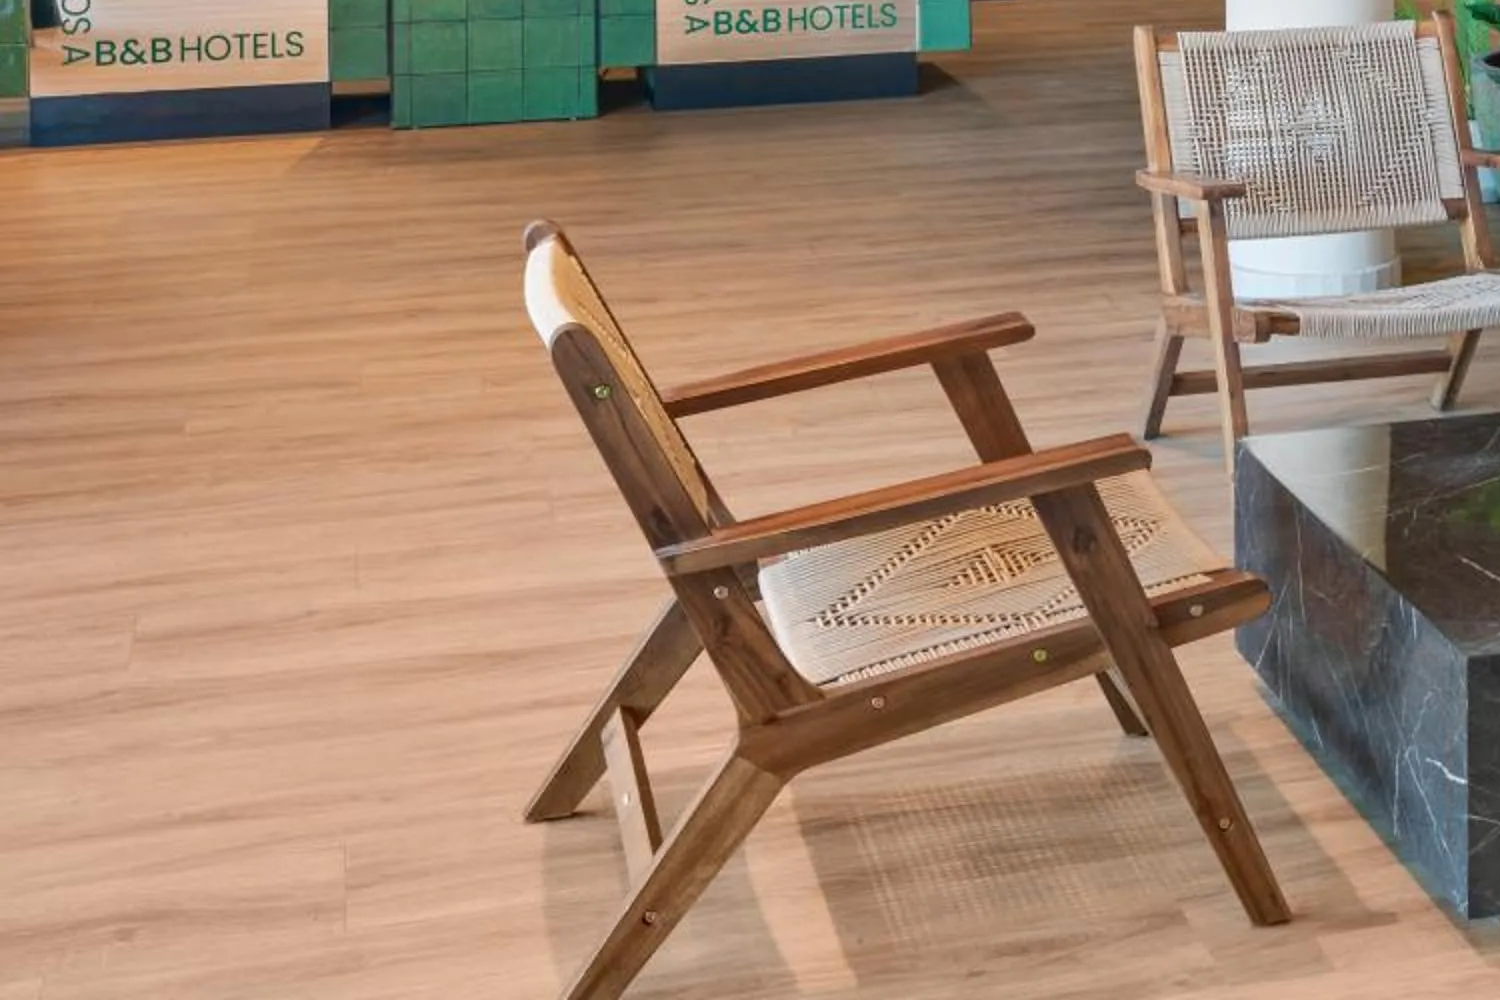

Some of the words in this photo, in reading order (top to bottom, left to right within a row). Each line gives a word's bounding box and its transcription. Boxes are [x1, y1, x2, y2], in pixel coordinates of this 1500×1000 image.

[685, 15, 710, 35] A
[714, 8, 781, 35] B&B
[788, 3, 897, 32] HOTELS
[61, 45, 91, 66] A
[95, 37, 173, 66] B&B
[180, 31, 304, 63] HOTELS
